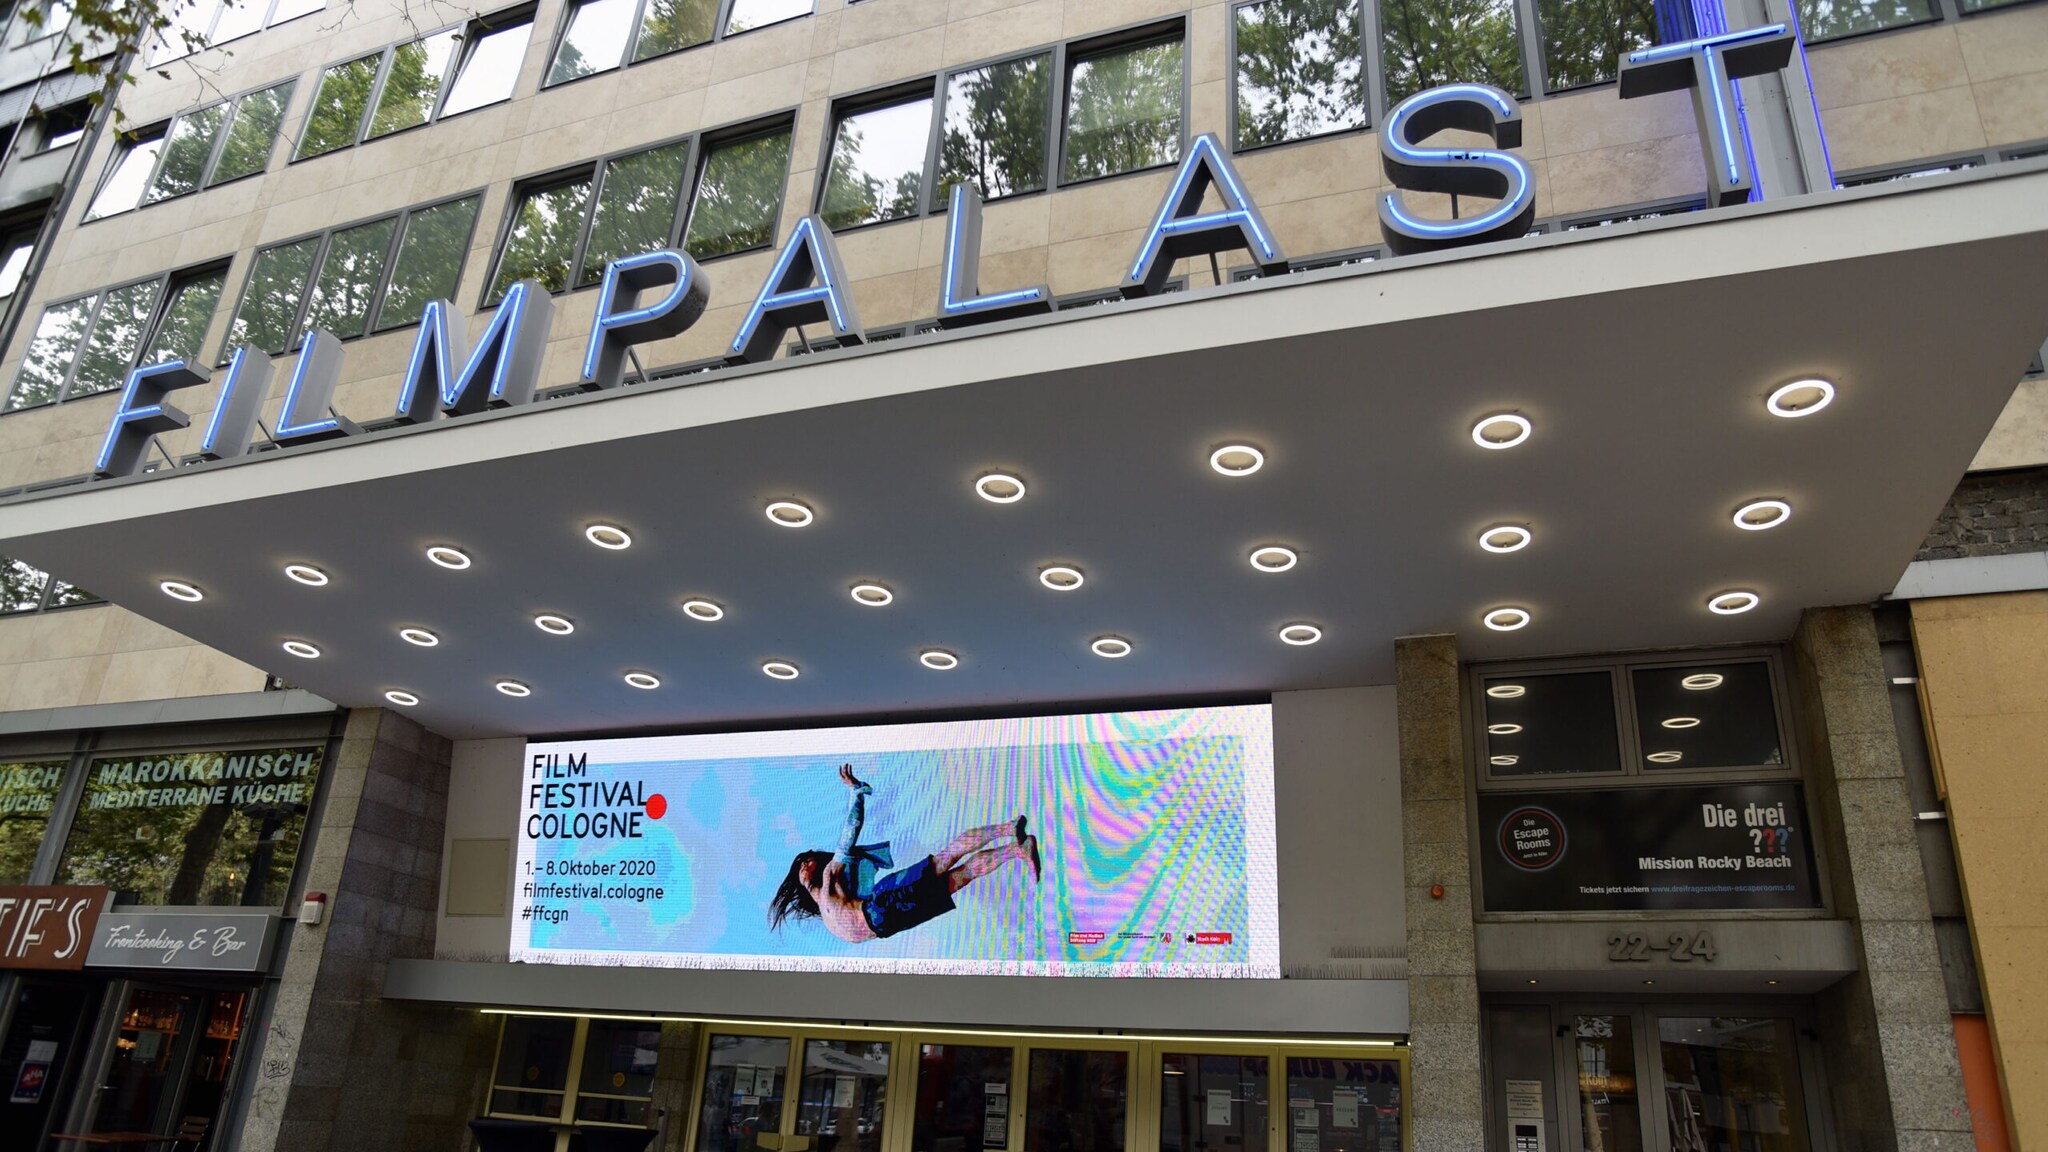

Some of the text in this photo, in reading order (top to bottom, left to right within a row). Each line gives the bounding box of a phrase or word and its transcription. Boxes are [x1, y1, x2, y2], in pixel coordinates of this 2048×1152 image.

[94, 22, 1798, 479] FILMPALAST
[97, 752, 314, 786] MAROKKANISCH
[532, 752, 587, 779] FILM
[89, 781, 306, 810] MEDITERRANE KÜCHE
[529, 780, 648, 809] FESTIVAL
[527, 811, 644, 840] COLOGNE
[1523, 819, 1535, 827] Die
[1702, 802, 1786, 828] Die drei
[1513, 827, 1550, 840] Escape
[1516, 838, 1551, 851] Rooms
[619, 860, 656, 876] 2020
[1638, 855, 1792, 871] Mission Rocky Beach
[523, 883, 664, 902] filmfestival.cologne
[1579, 886, 1605, 894] Tickets
[1606, 886, 1622, 895] jetzt
[1623, 886, 1649, 894] sichern
[522, 905, 569, 924] #ffcgn
[105, 925, 246, 964] Frontcooking & Bar
[1608, 929, 1716, 962] 22-24
